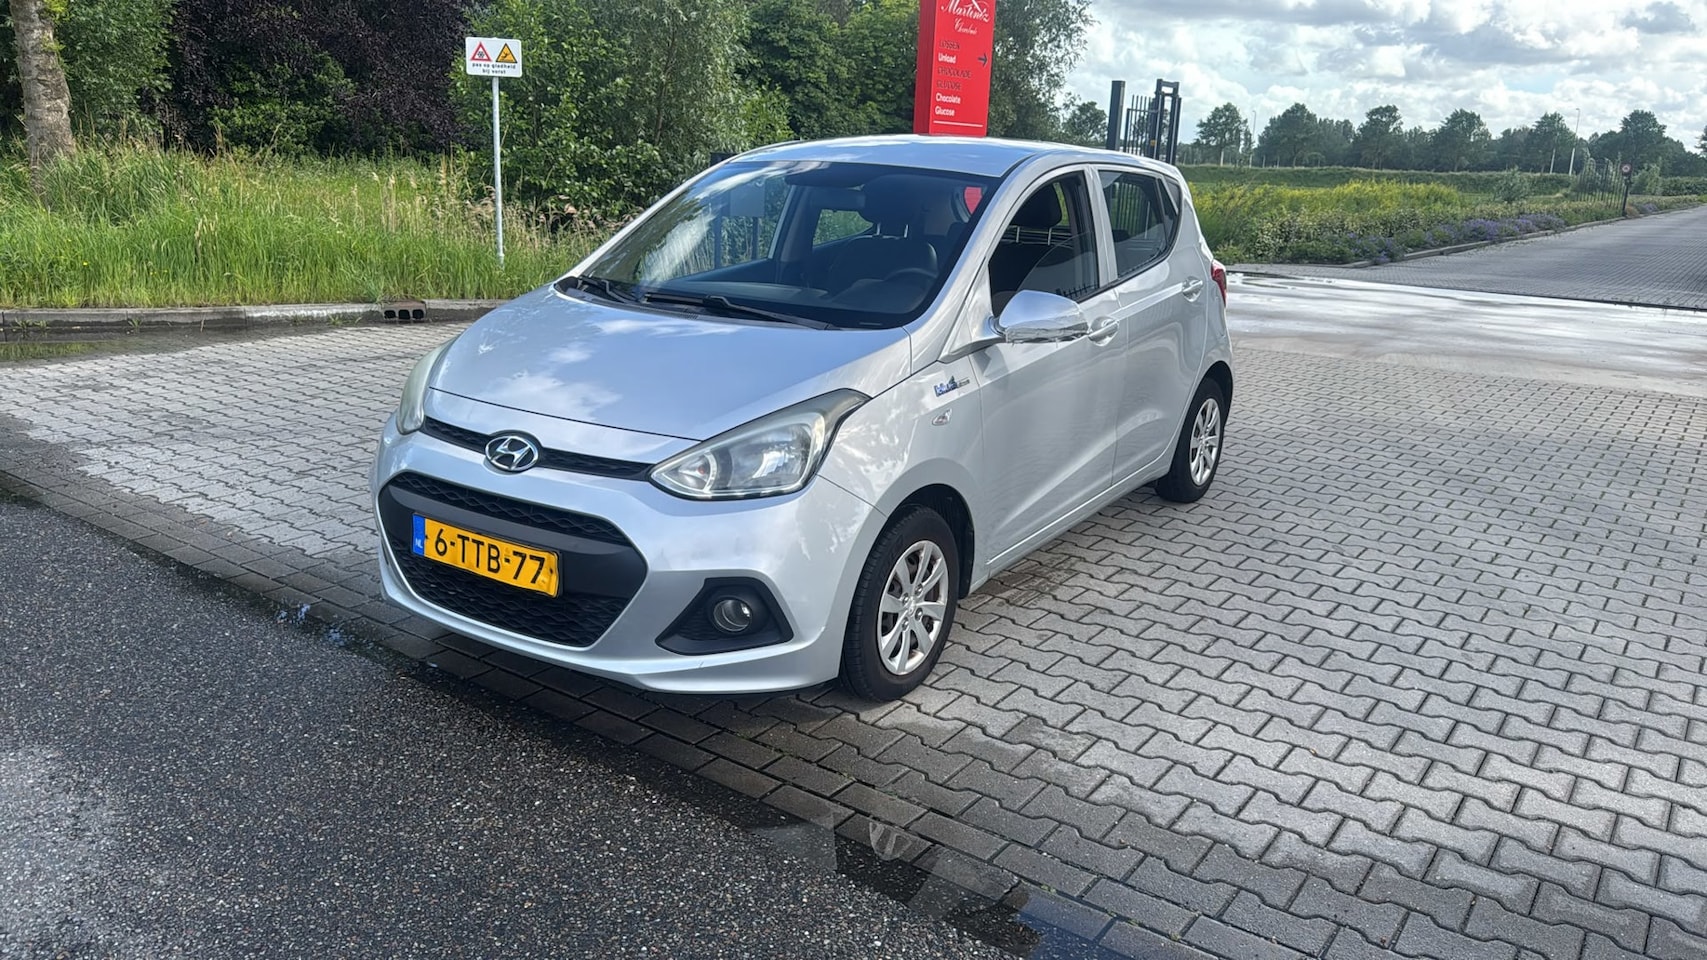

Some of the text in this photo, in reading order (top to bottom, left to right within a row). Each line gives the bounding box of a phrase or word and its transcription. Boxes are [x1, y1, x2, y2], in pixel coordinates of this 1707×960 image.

[938, 52, 957, 64] Unload
[935, 92, 961, 104] Chocolate
[935, 105, 955, 117] Glucose
[415, 528, 546, 584] NL 6-TTB-77
